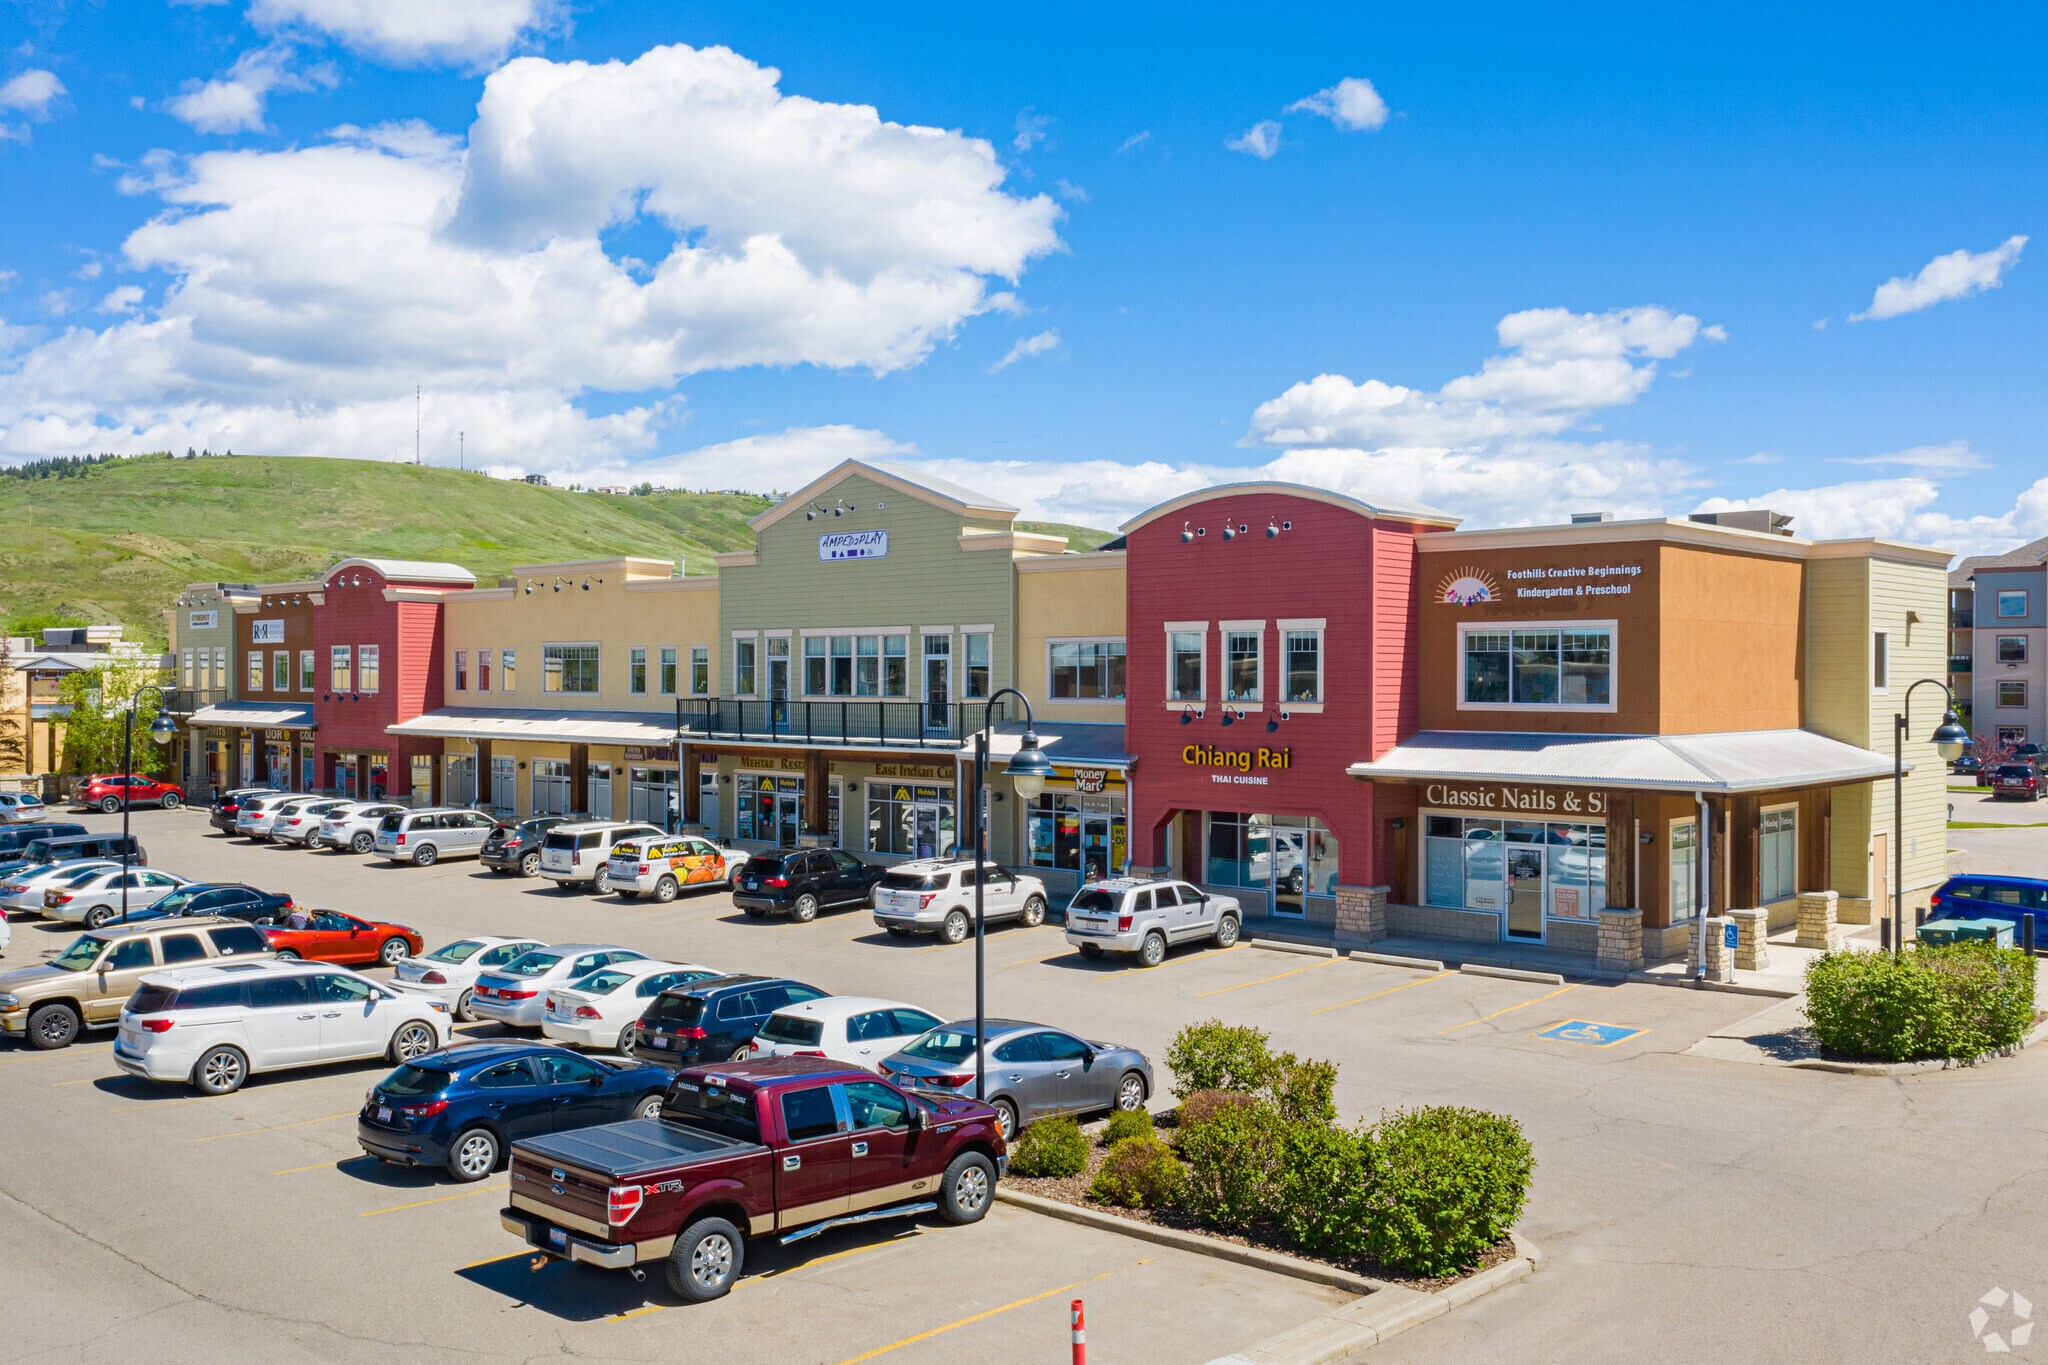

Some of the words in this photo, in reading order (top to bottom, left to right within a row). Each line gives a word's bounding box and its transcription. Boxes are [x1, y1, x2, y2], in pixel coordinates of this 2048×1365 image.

[822, 531, 884, 547] AMPED2PLAY
[1507, 568, 1546, 579] Foothills
[1548, 567, 1586, 578] Creative
[1588, 565, 1641, 578] Beginnings
[1517, 587, 1573, 599] Kindergarten
[1576, 586, 1583, 596] &
[1585, 584, 1631, 595] Preschool
[1182, 745, 1251, 772] Chiang
[1258, 747, 1290, 769] Rai
[875, 763, 897, 776] East
[900, 764, 933, 778] Indian
[1074, 769, 1106, 783] Money
[1075, 778, 1101, 792] Mart
[1211, 774, 1232, 784] THAI
[1233, 776, 1268, 785] CUISINE
[1426, 784, 1495, 808] Classic
[1501, 787, 1556, 811] Nails
[1562, 790, 1582, 812] &
[1556, 892, 1577, 900] CLOSED
